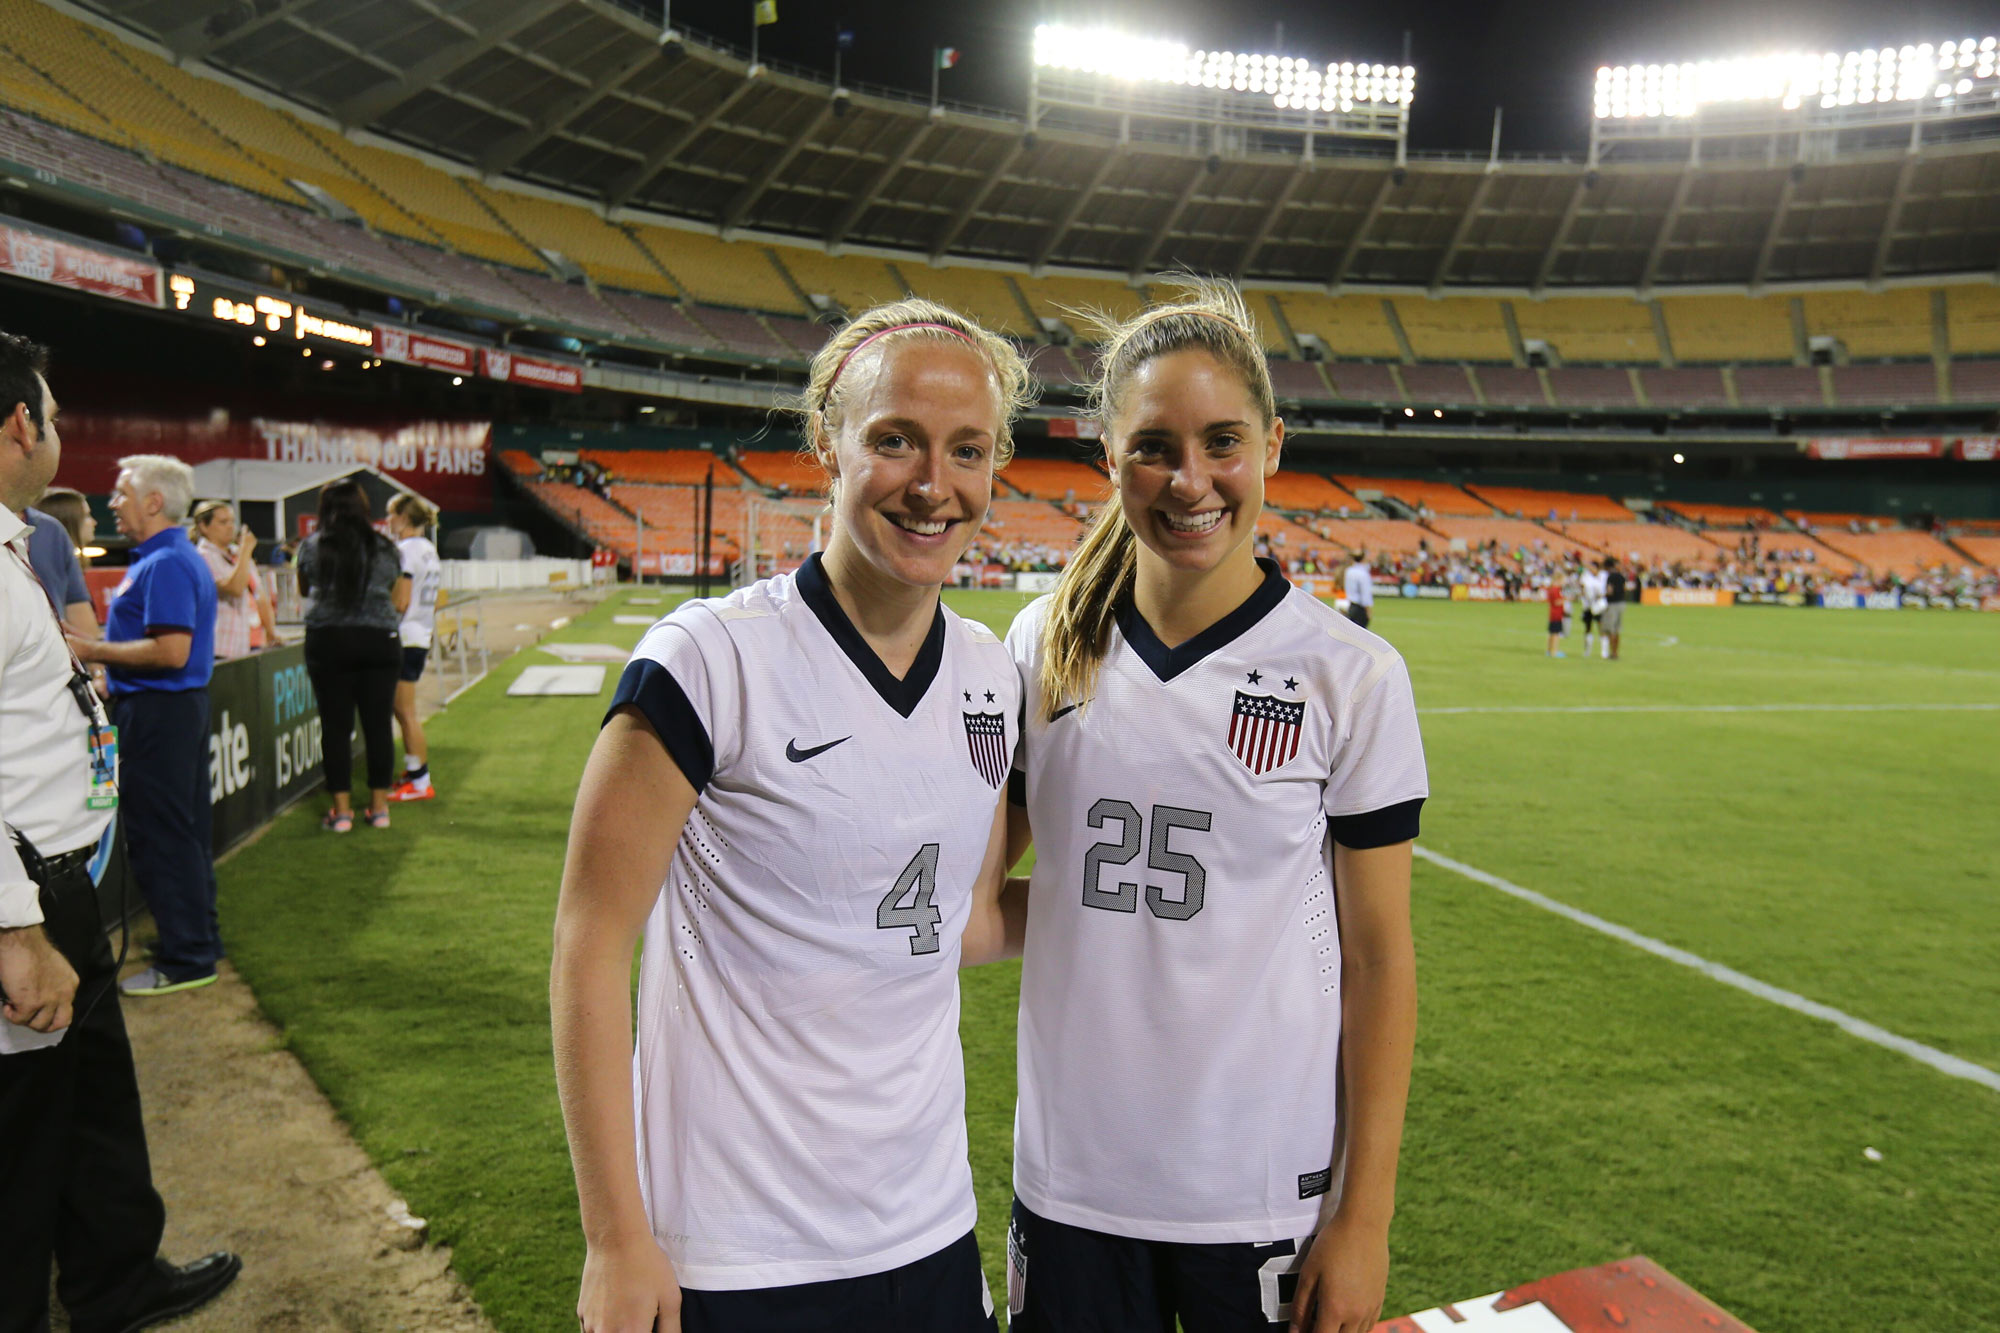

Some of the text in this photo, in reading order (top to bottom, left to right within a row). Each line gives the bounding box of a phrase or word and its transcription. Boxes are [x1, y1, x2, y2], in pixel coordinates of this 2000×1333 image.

[262, 430, 353, 464] THANK
[423, 445, 485, 475] FANS
[275, 715, 323, 789] IS OUR
[877, 843, 942, 956] 4
[1082, 798, 1212, 921] 25
